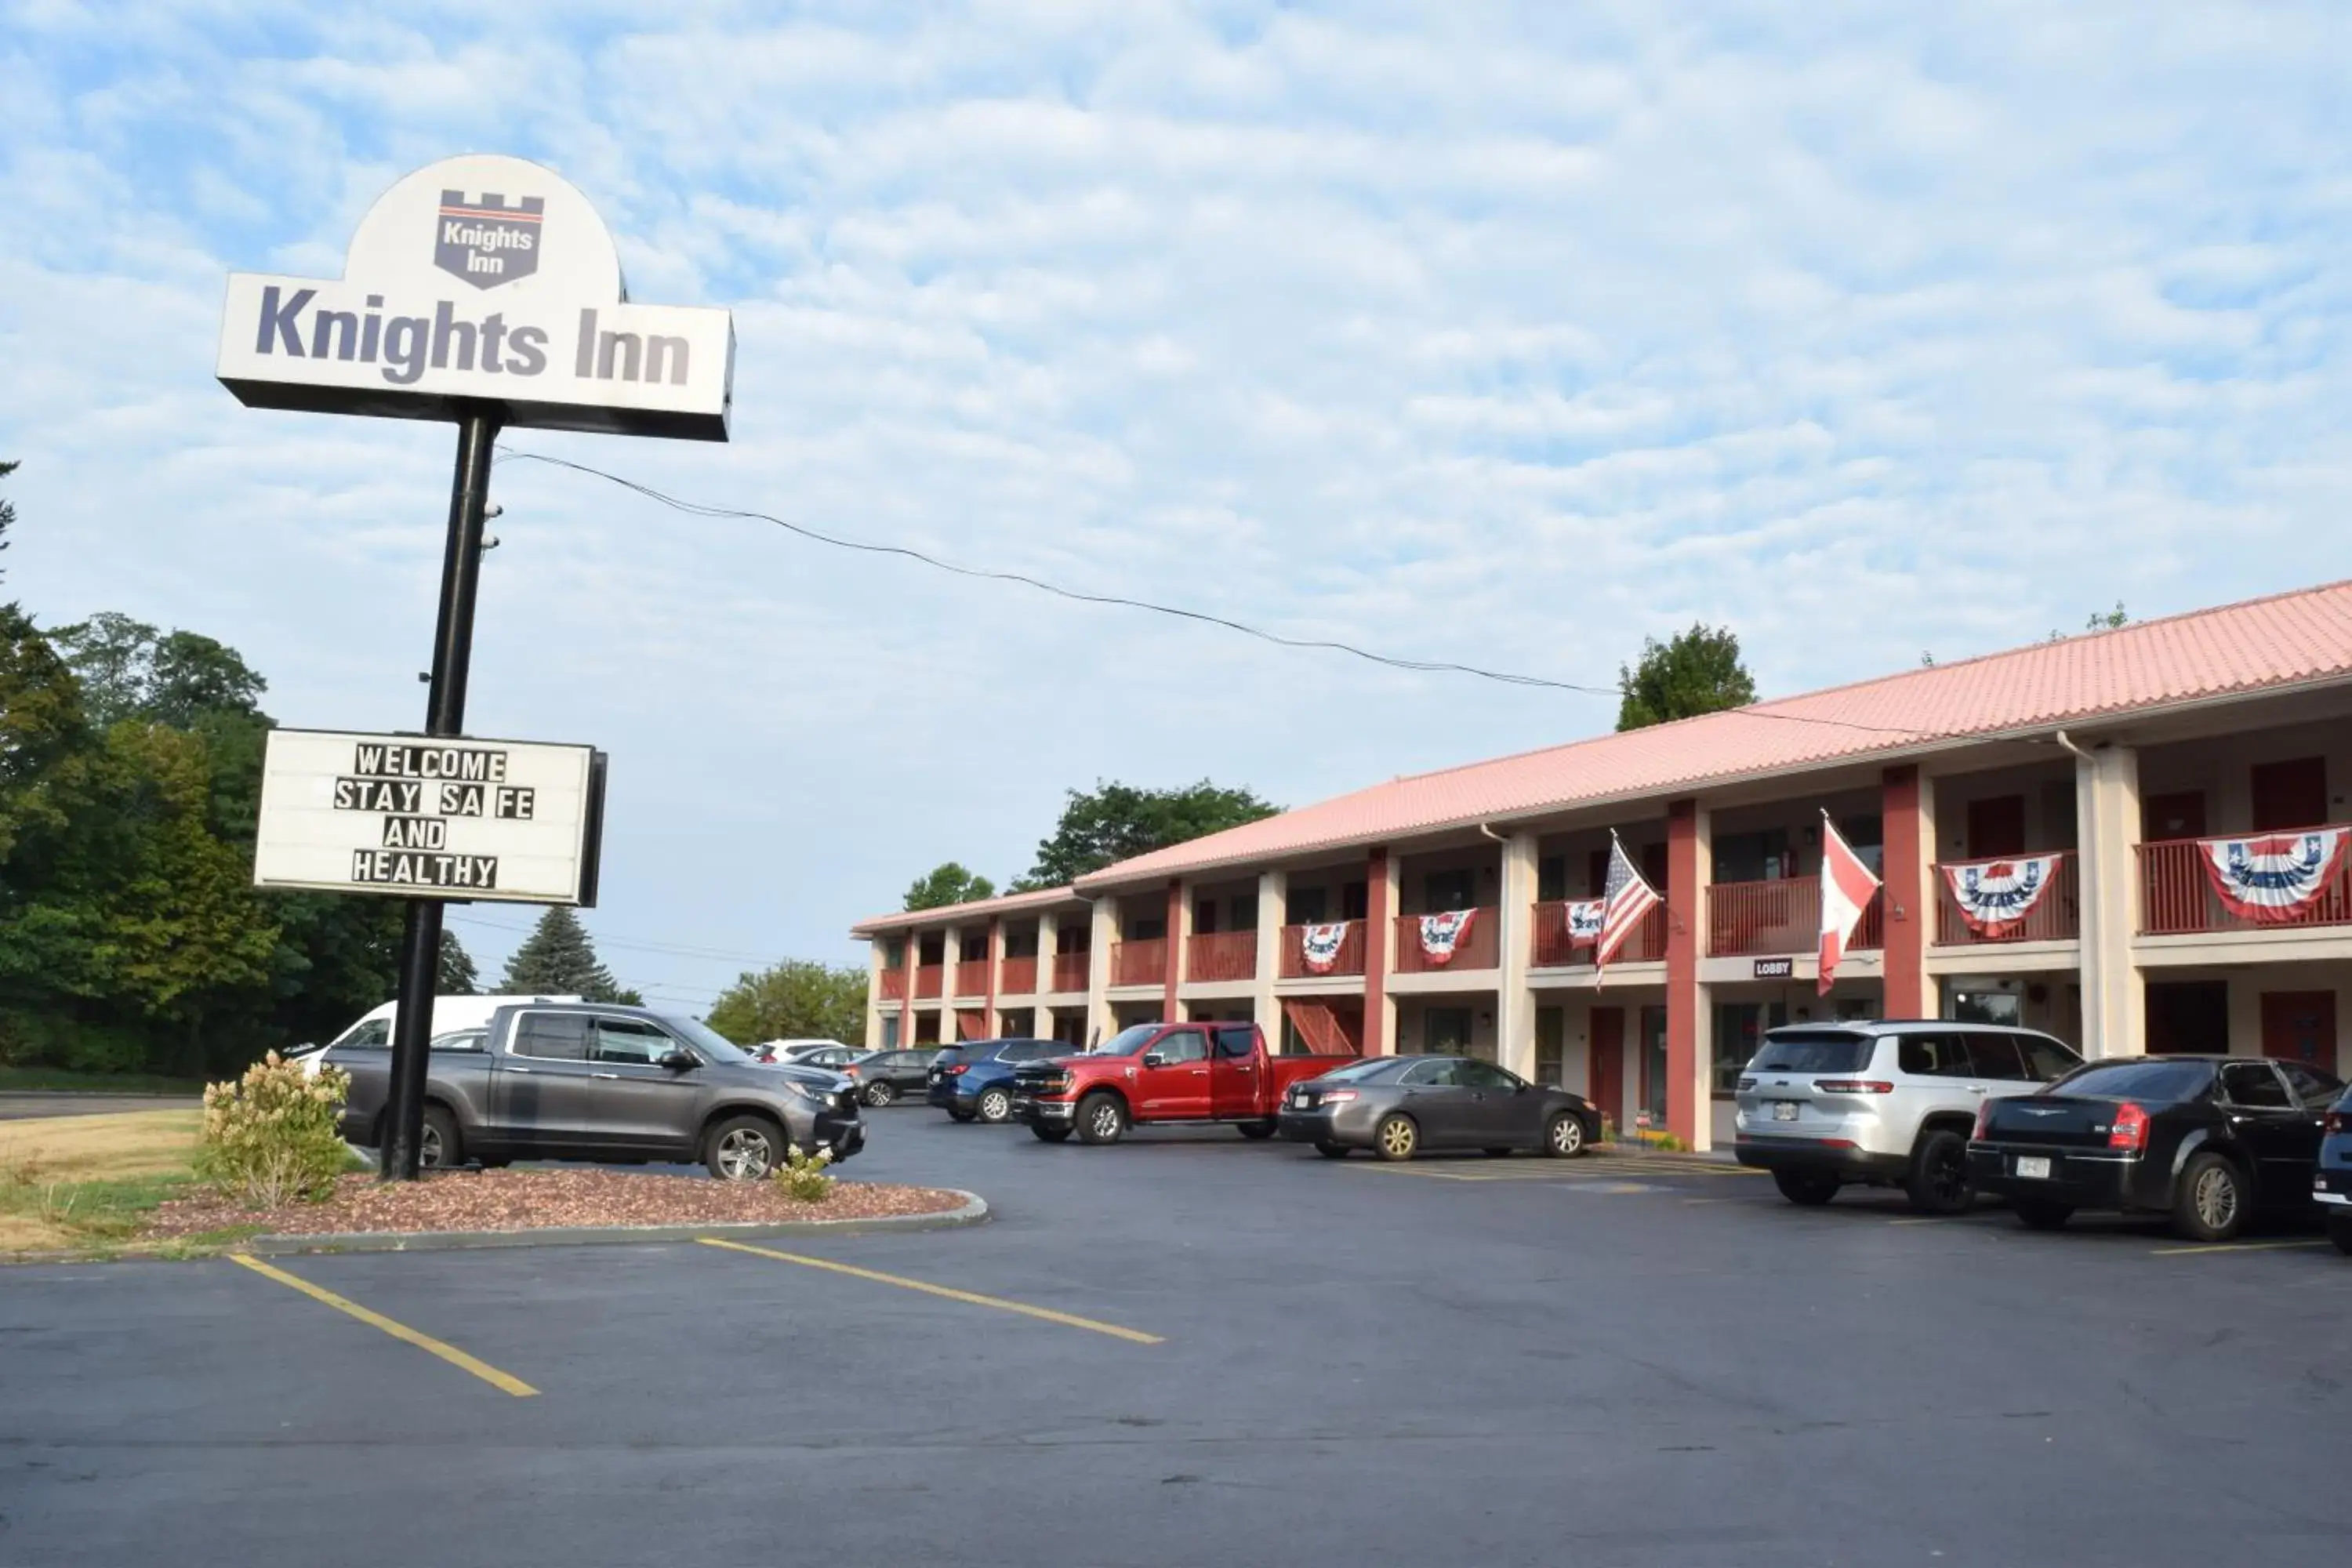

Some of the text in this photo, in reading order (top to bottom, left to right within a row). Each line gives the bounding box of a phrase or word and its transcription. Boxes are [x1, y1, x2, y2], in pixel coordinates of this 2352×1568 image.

[444, 221, 533, 252] Knights
[467, 249, 504, 274] Inn
[256, 285, 689, 385] Knights Inn
[356, 746, 506, 782] WELCOME
[335, 781, 419, 812] STAY
[383, 818, 445, 848] AND
[354, 852, 496, 887] HEALTHY
[1757, 962, 1789, 975] LOBBY
